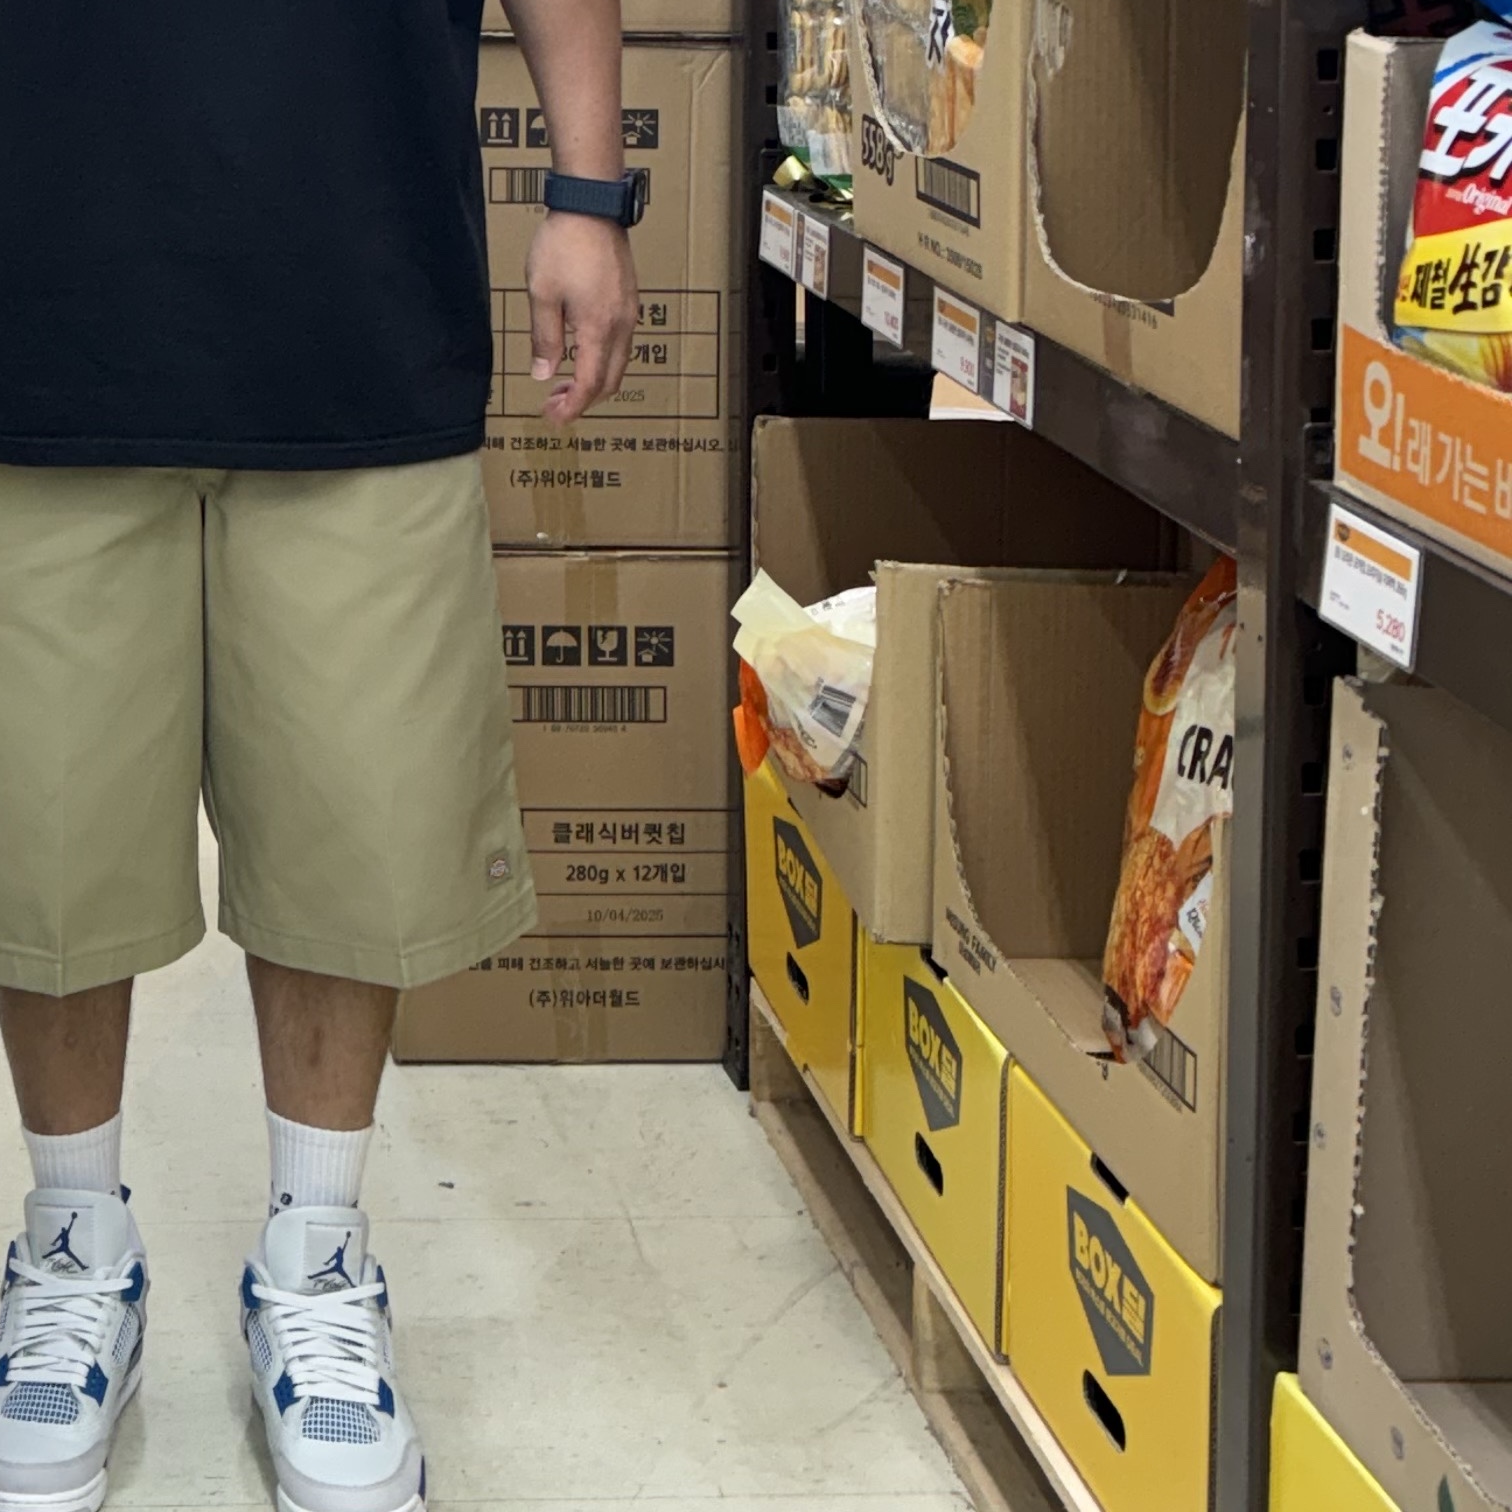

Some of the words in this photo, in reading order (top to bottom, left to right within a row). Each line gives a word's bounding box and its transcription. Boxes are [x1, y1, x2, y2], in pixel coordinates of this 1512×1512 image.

[1412, 256, 1449, 311] 제철
[1450, 241, 1512, 316] 生감
[510, 436, 562, 451] 건조하고
[567, 436, 606, 452] 서늘한
[611, 436, 637, 452] 곳에
[509, 469, 622, 489] (주)위아더월드
[1375, 607, 1406, 643] 5,280
[1177, 722, 1235, 790] CRA
[565, 864, 609, 884] 280g
[615, 868, 626, 882] x
[633, 862, 687, 884] 12개입
[497, 956, 524, 971] 피해
[529, 955, 580, 971] 건조하고
[585, 955, 624, 971] 서늘한
[630, 955, 656, 972] 곳에
[528, 989, 641, 1008] (주)위아더월드
